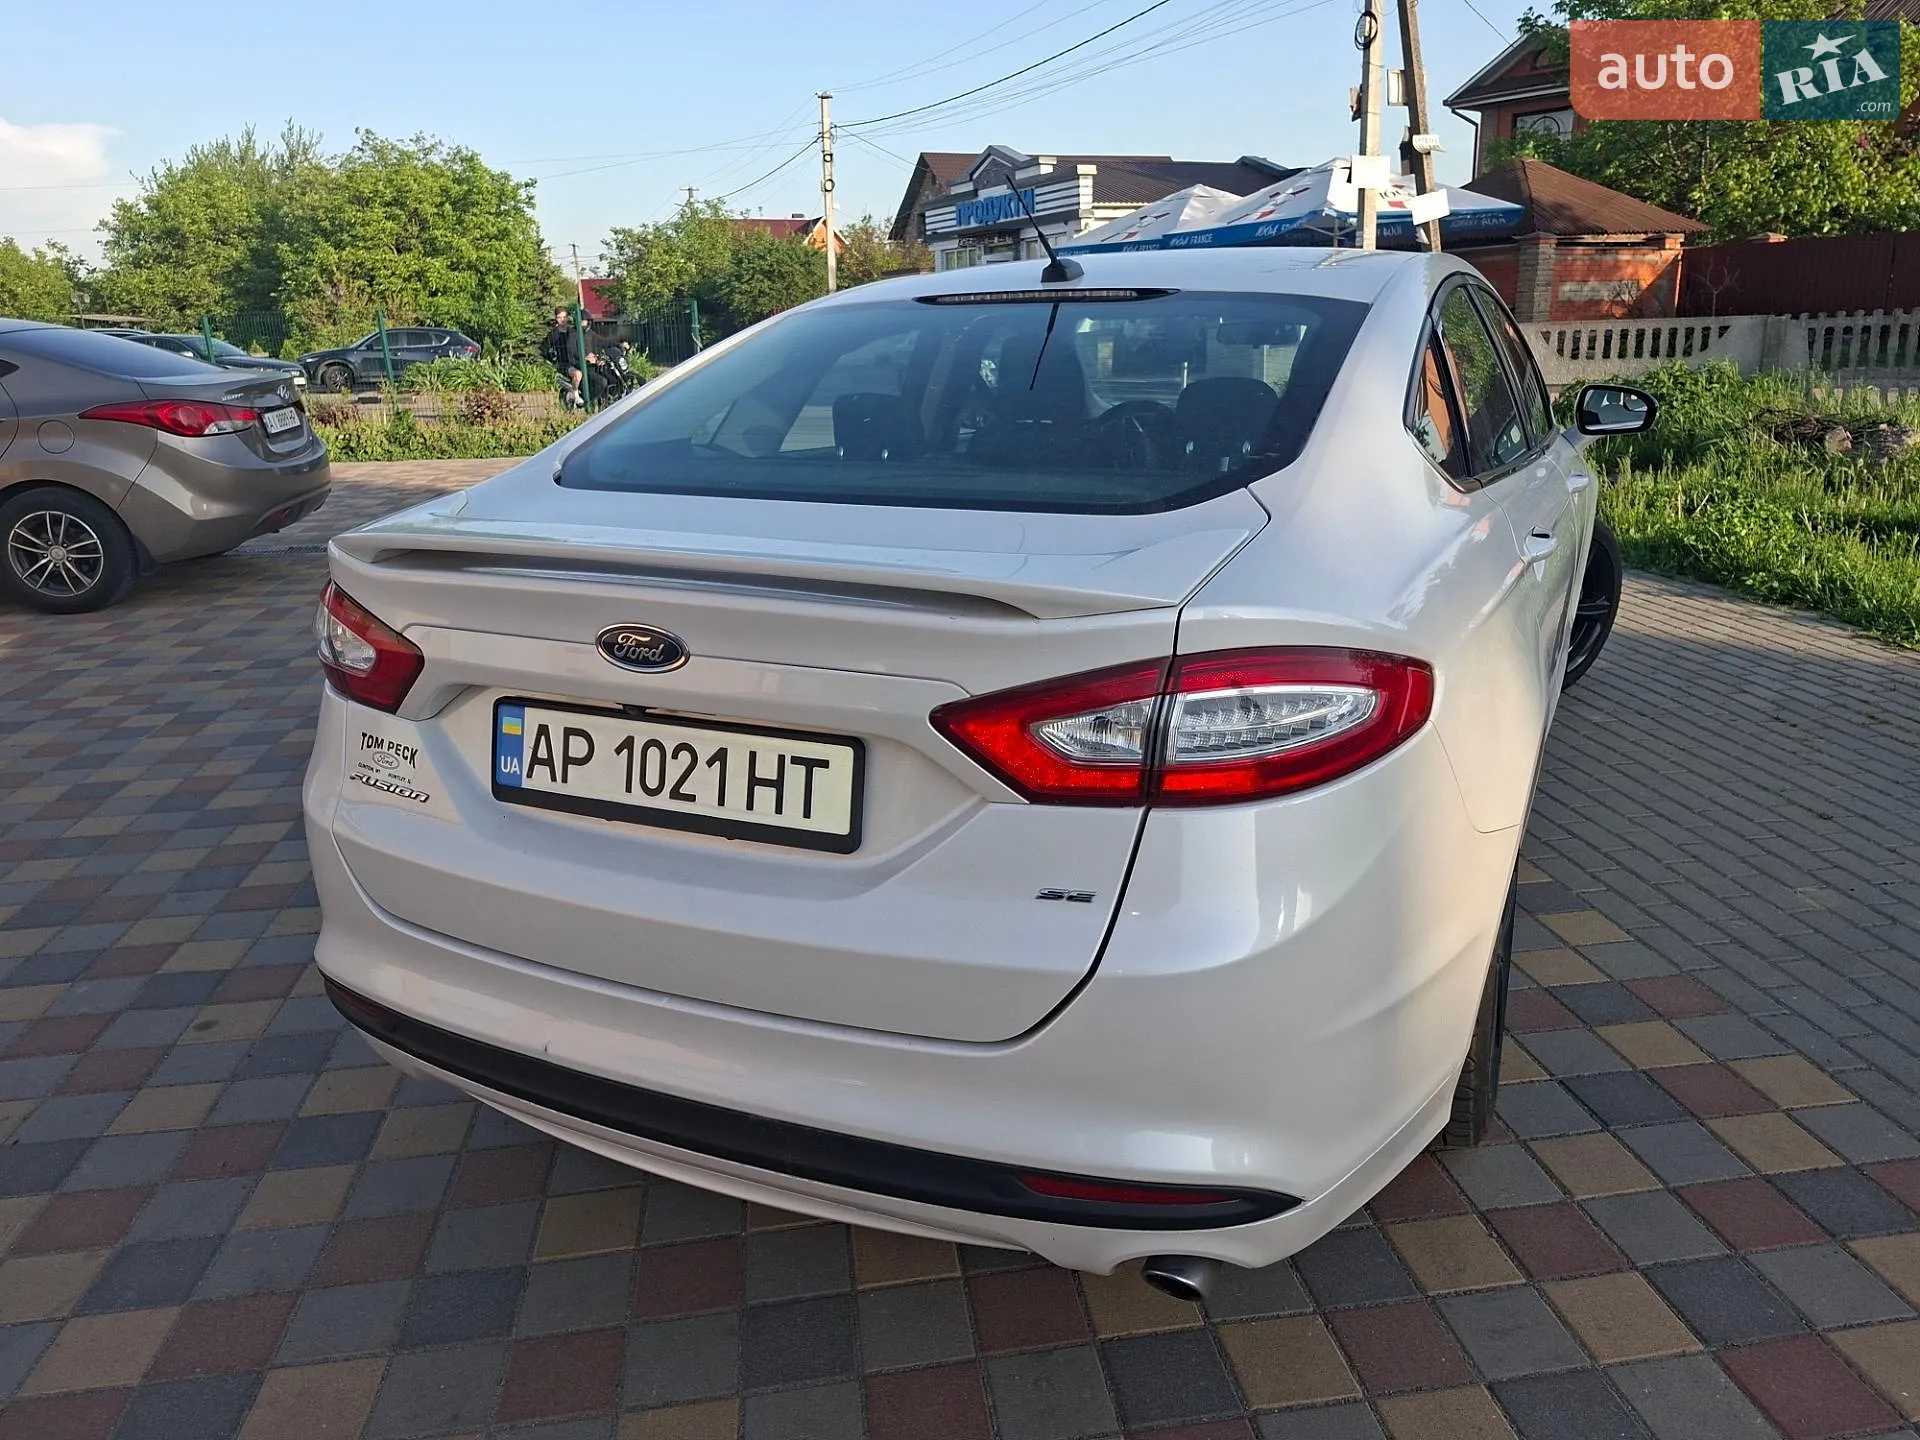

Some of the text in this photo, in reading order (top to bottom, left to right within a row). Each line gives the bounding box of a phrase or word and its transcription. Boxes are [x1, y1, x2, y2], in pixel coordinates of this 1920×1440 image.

[613, 633, 664, 661] Ford
[360, 731, 418, 769] TOM PECK
[500, 755, 520, 776] UA
[526, 724, 830, 819] AP 1021 HT
[1035, 888, 1097, 903] SE
